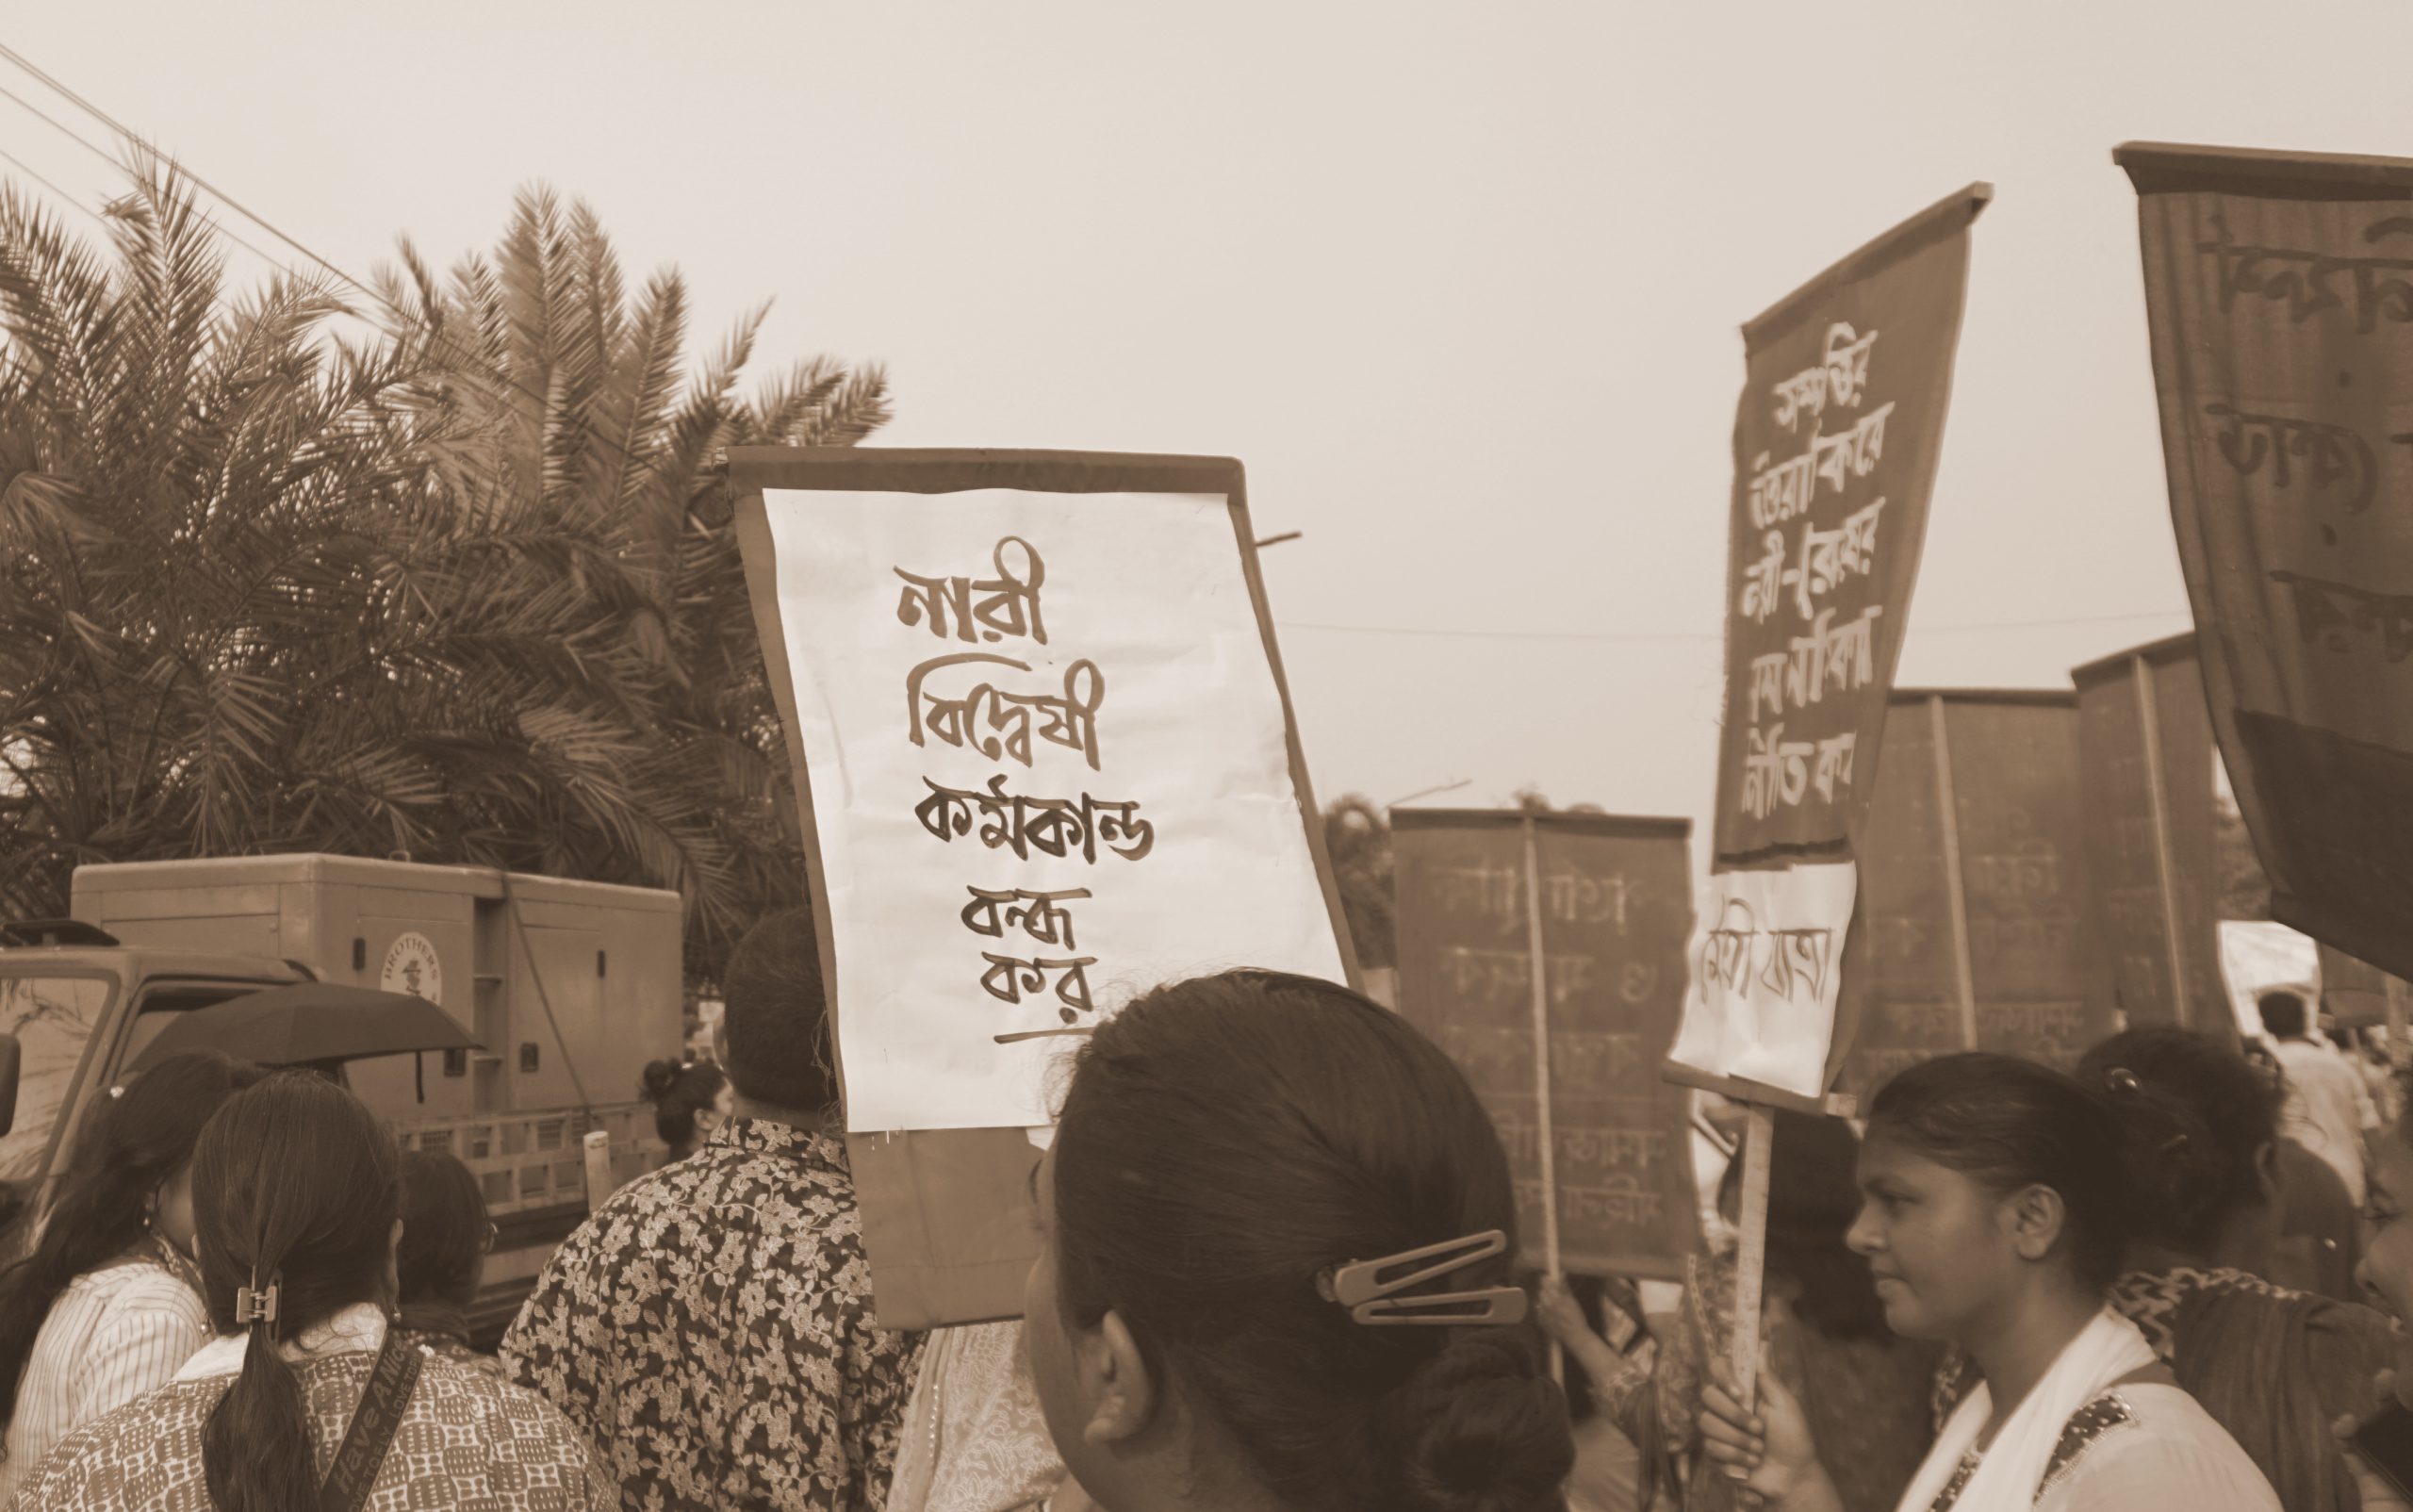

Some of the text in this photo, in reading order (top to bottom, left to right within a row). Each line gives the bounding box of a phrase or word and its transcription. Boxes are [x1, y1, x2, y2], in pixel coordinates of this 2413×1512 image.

[893, 534, 1048, 646] নারী
[906, 652, 1105, 771] বিদ্বেষী
[960, 884, 1092, 951] বন্ধ
[980, 951, 1099, 1024] কর
[333, 1407, 380, 1496] Have
[372, 1381, 392, 1409] A
[348, 1482, 370, 1512] OVE
